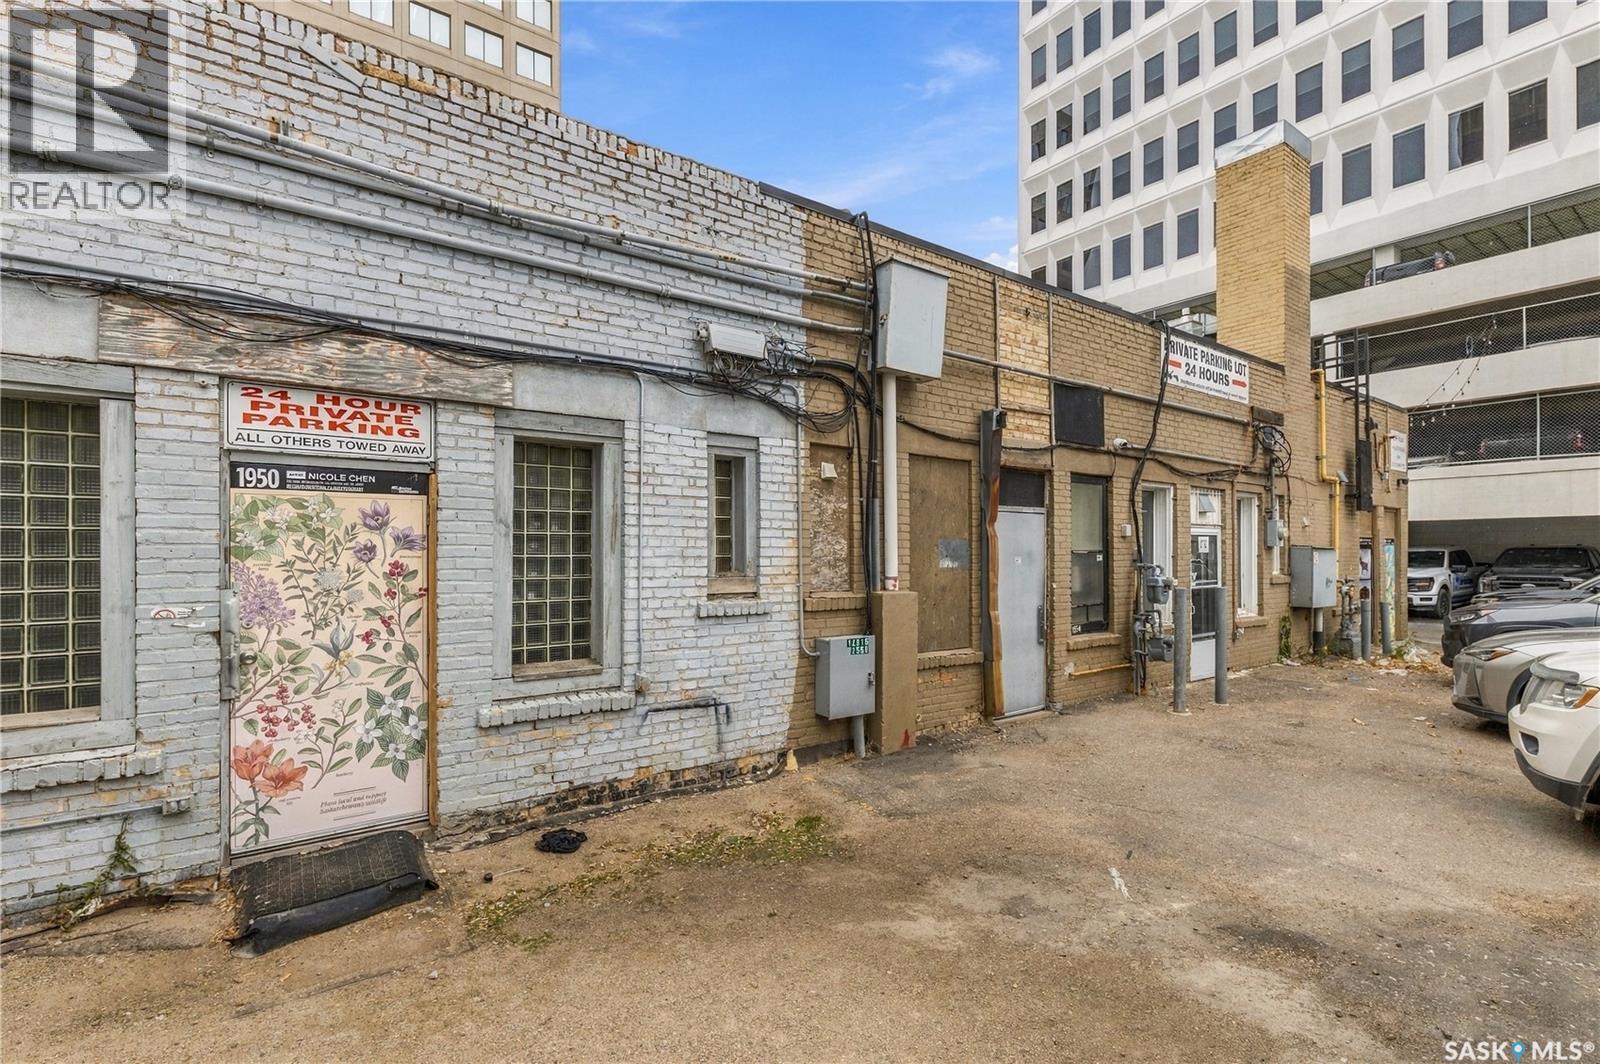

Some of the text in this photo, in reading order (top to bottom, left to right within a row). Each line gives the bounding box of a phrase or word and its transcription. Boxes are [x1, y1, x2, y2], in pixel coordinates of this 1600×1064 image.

[1185, 362, 1230, 387] 24 HOURS
[1200, 350, 1233, 373] PARKING
[1235, 361, 1247, 377] LOT
[240, 386, 422, 415] 24 HOUR
[250, 400, 415, 426] PRIVATE
[242, 412, 421, 439] PARKING
[234, 432, 427, 456] ALL OTHERS TOWED AWAY
[236, 467, 280, 489] 1950
[308, 472, 347, 482] NICOLE
[348, 474, 376, 483] CHEN
